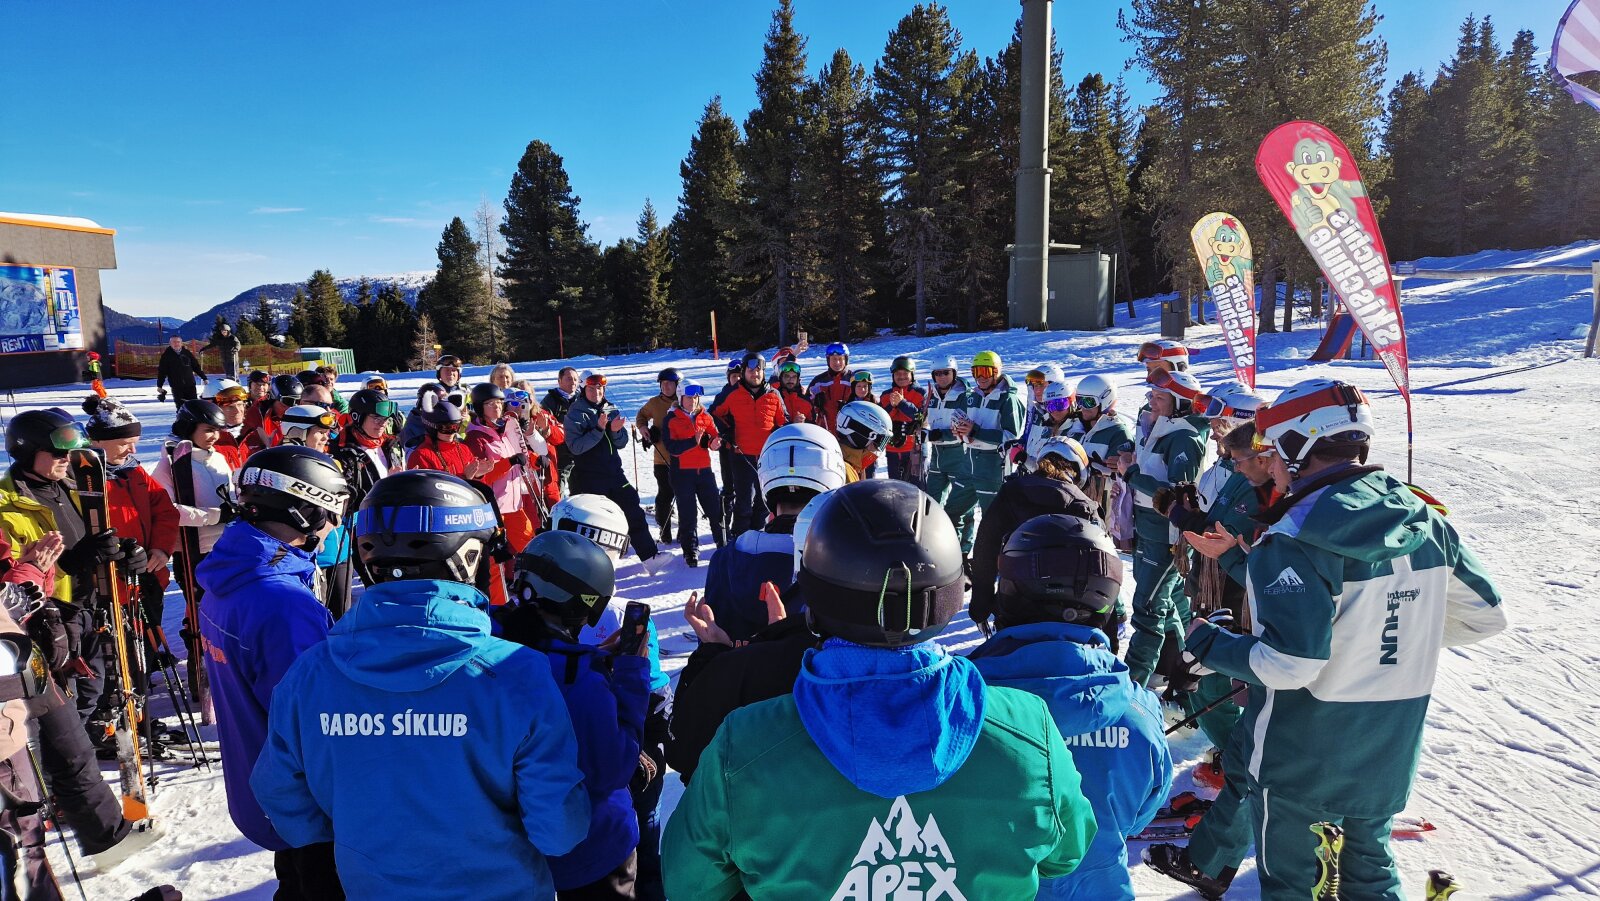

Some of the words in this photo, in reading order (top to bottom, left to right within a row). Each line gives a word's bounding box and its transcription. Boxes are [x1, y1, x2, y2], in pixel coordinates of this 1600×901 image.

[1, 336, 26, 353] RENT
[291, 482, 342, 506] RUDY
[444, 513, 472, 525] HEAVY
[1379, 601, 1400, 665] HUN
[319, 712, 386, 737] BABOS
[391, 708, 468, 737] SÍKLUB
[829, 862, 968, 901] APEX
